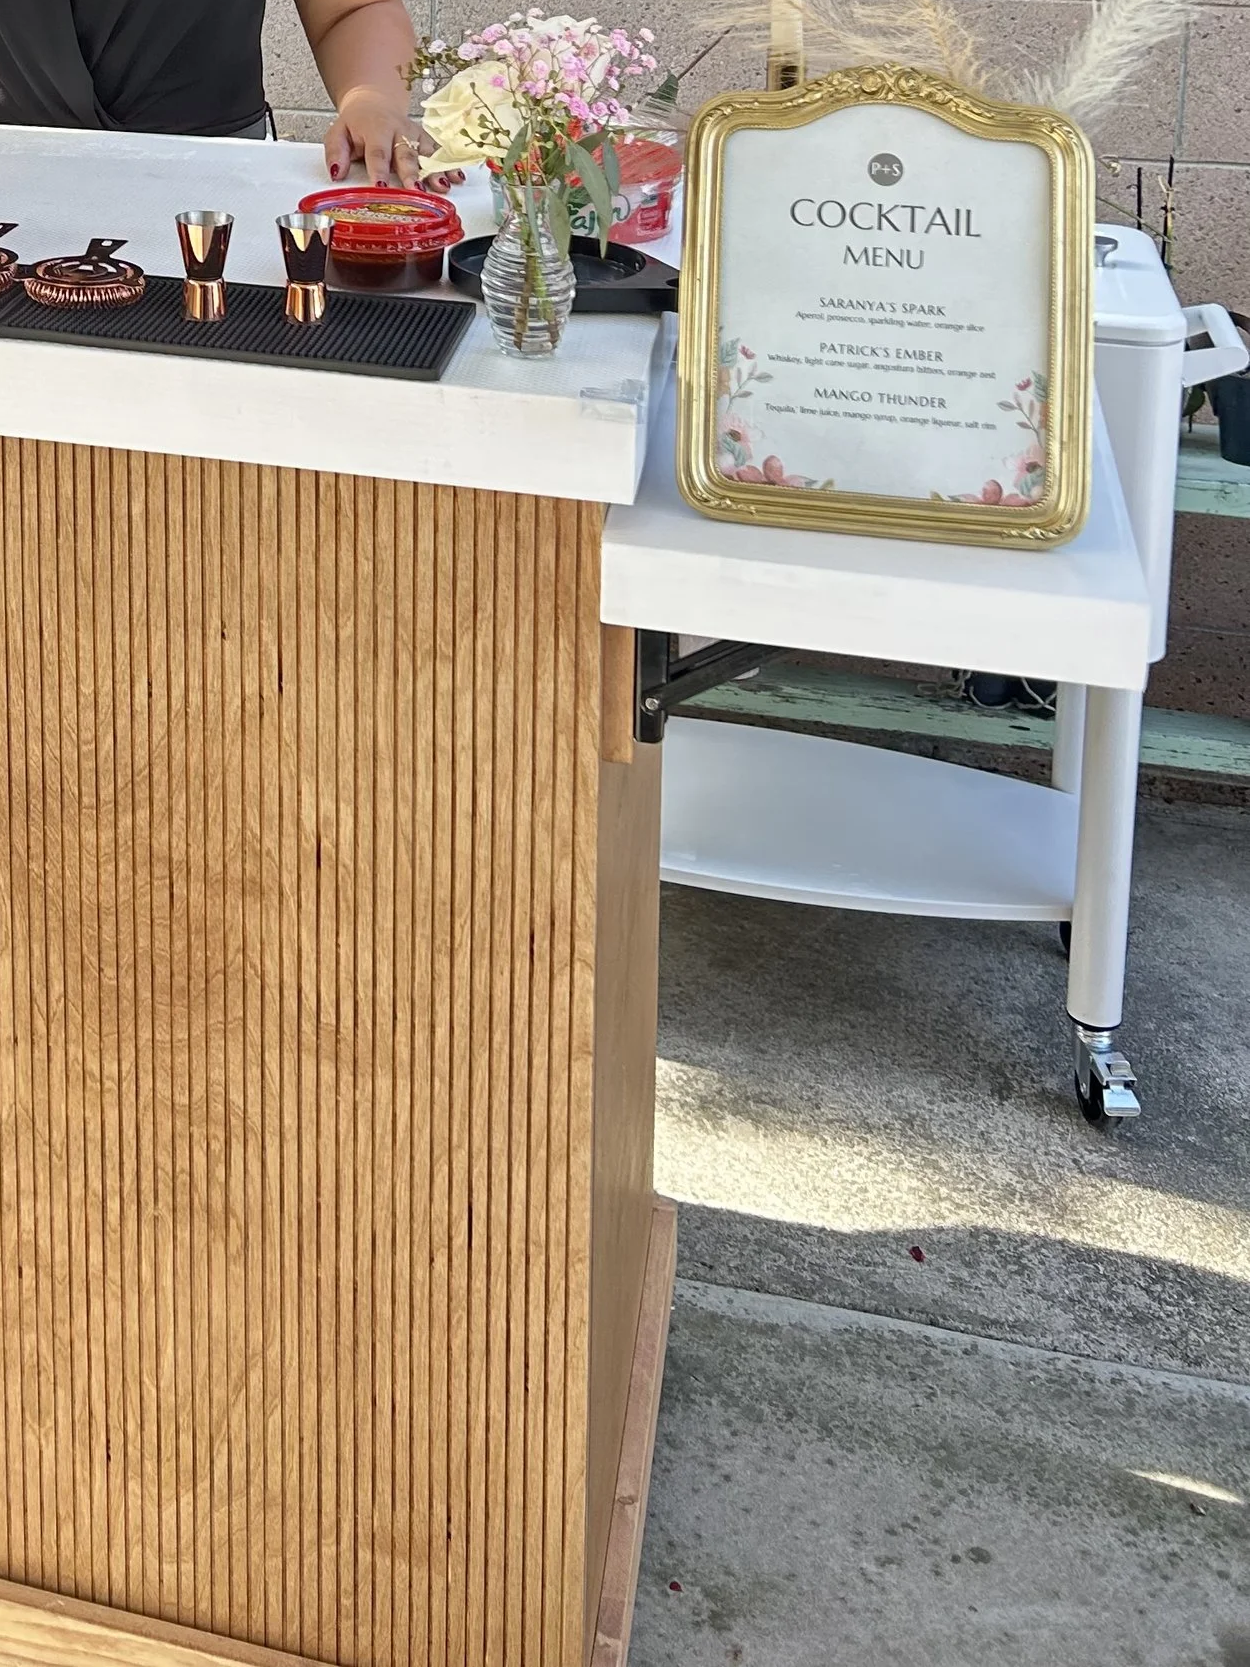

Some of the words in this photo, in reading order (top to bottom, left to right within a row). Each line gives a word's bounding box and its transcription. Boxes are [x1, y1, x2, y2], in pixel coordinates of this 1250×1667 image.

[871, 161, 900, 177] P+S
[789, 198, 982, 238] COCKTAIL
[842, 245, 925, 270] MENU
[819, 296, 897, 314] SARANYA'S
[902, 302, 947, 317] SPARK
[868, 317, 905, 328] sparkling
[934, 322, 965, 332] orange
[819, 342, 890, 359] PATRICK'S
[895, 348, 944, 362] EMBER
[804, 356, 824, 367] light
[947, 369, 978, 380] orange
[813, 387, 873, 403] MANGO
[878, 392, 947, 409] THUNDER
[799, 406, 818, 415] lime
[842, 411, 872, 421] mango
[899, 416, 930, 427] orange
[965, 421, 979, 429] salt
